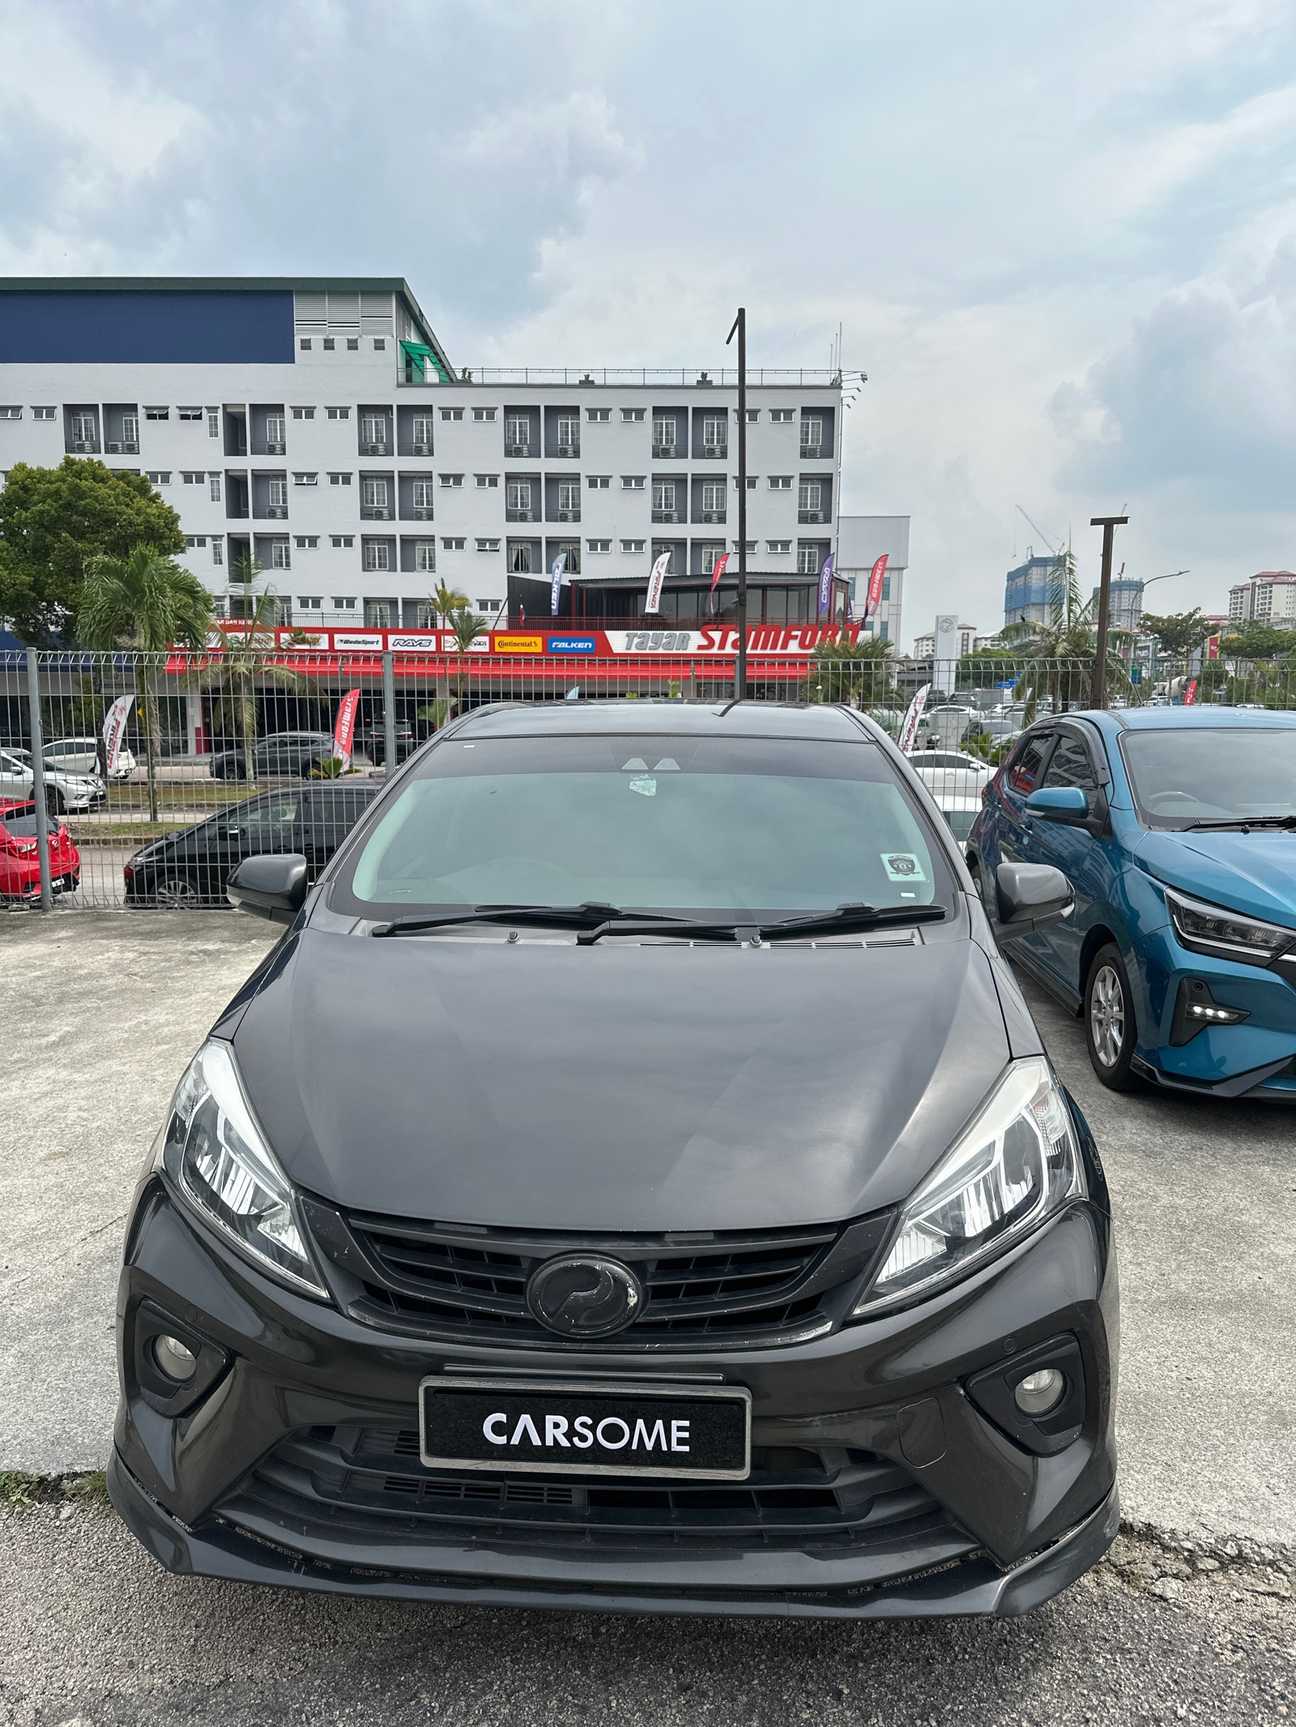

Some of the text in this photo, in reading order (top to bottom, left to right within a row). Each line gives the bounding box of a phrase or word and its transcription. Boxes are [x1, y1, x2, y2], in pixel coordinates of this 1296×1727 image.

[392, 638, 432, 647] RAYS
[498, 640, 532, 648] Continental
[482, 1412, 690, 1452] CARSOME
